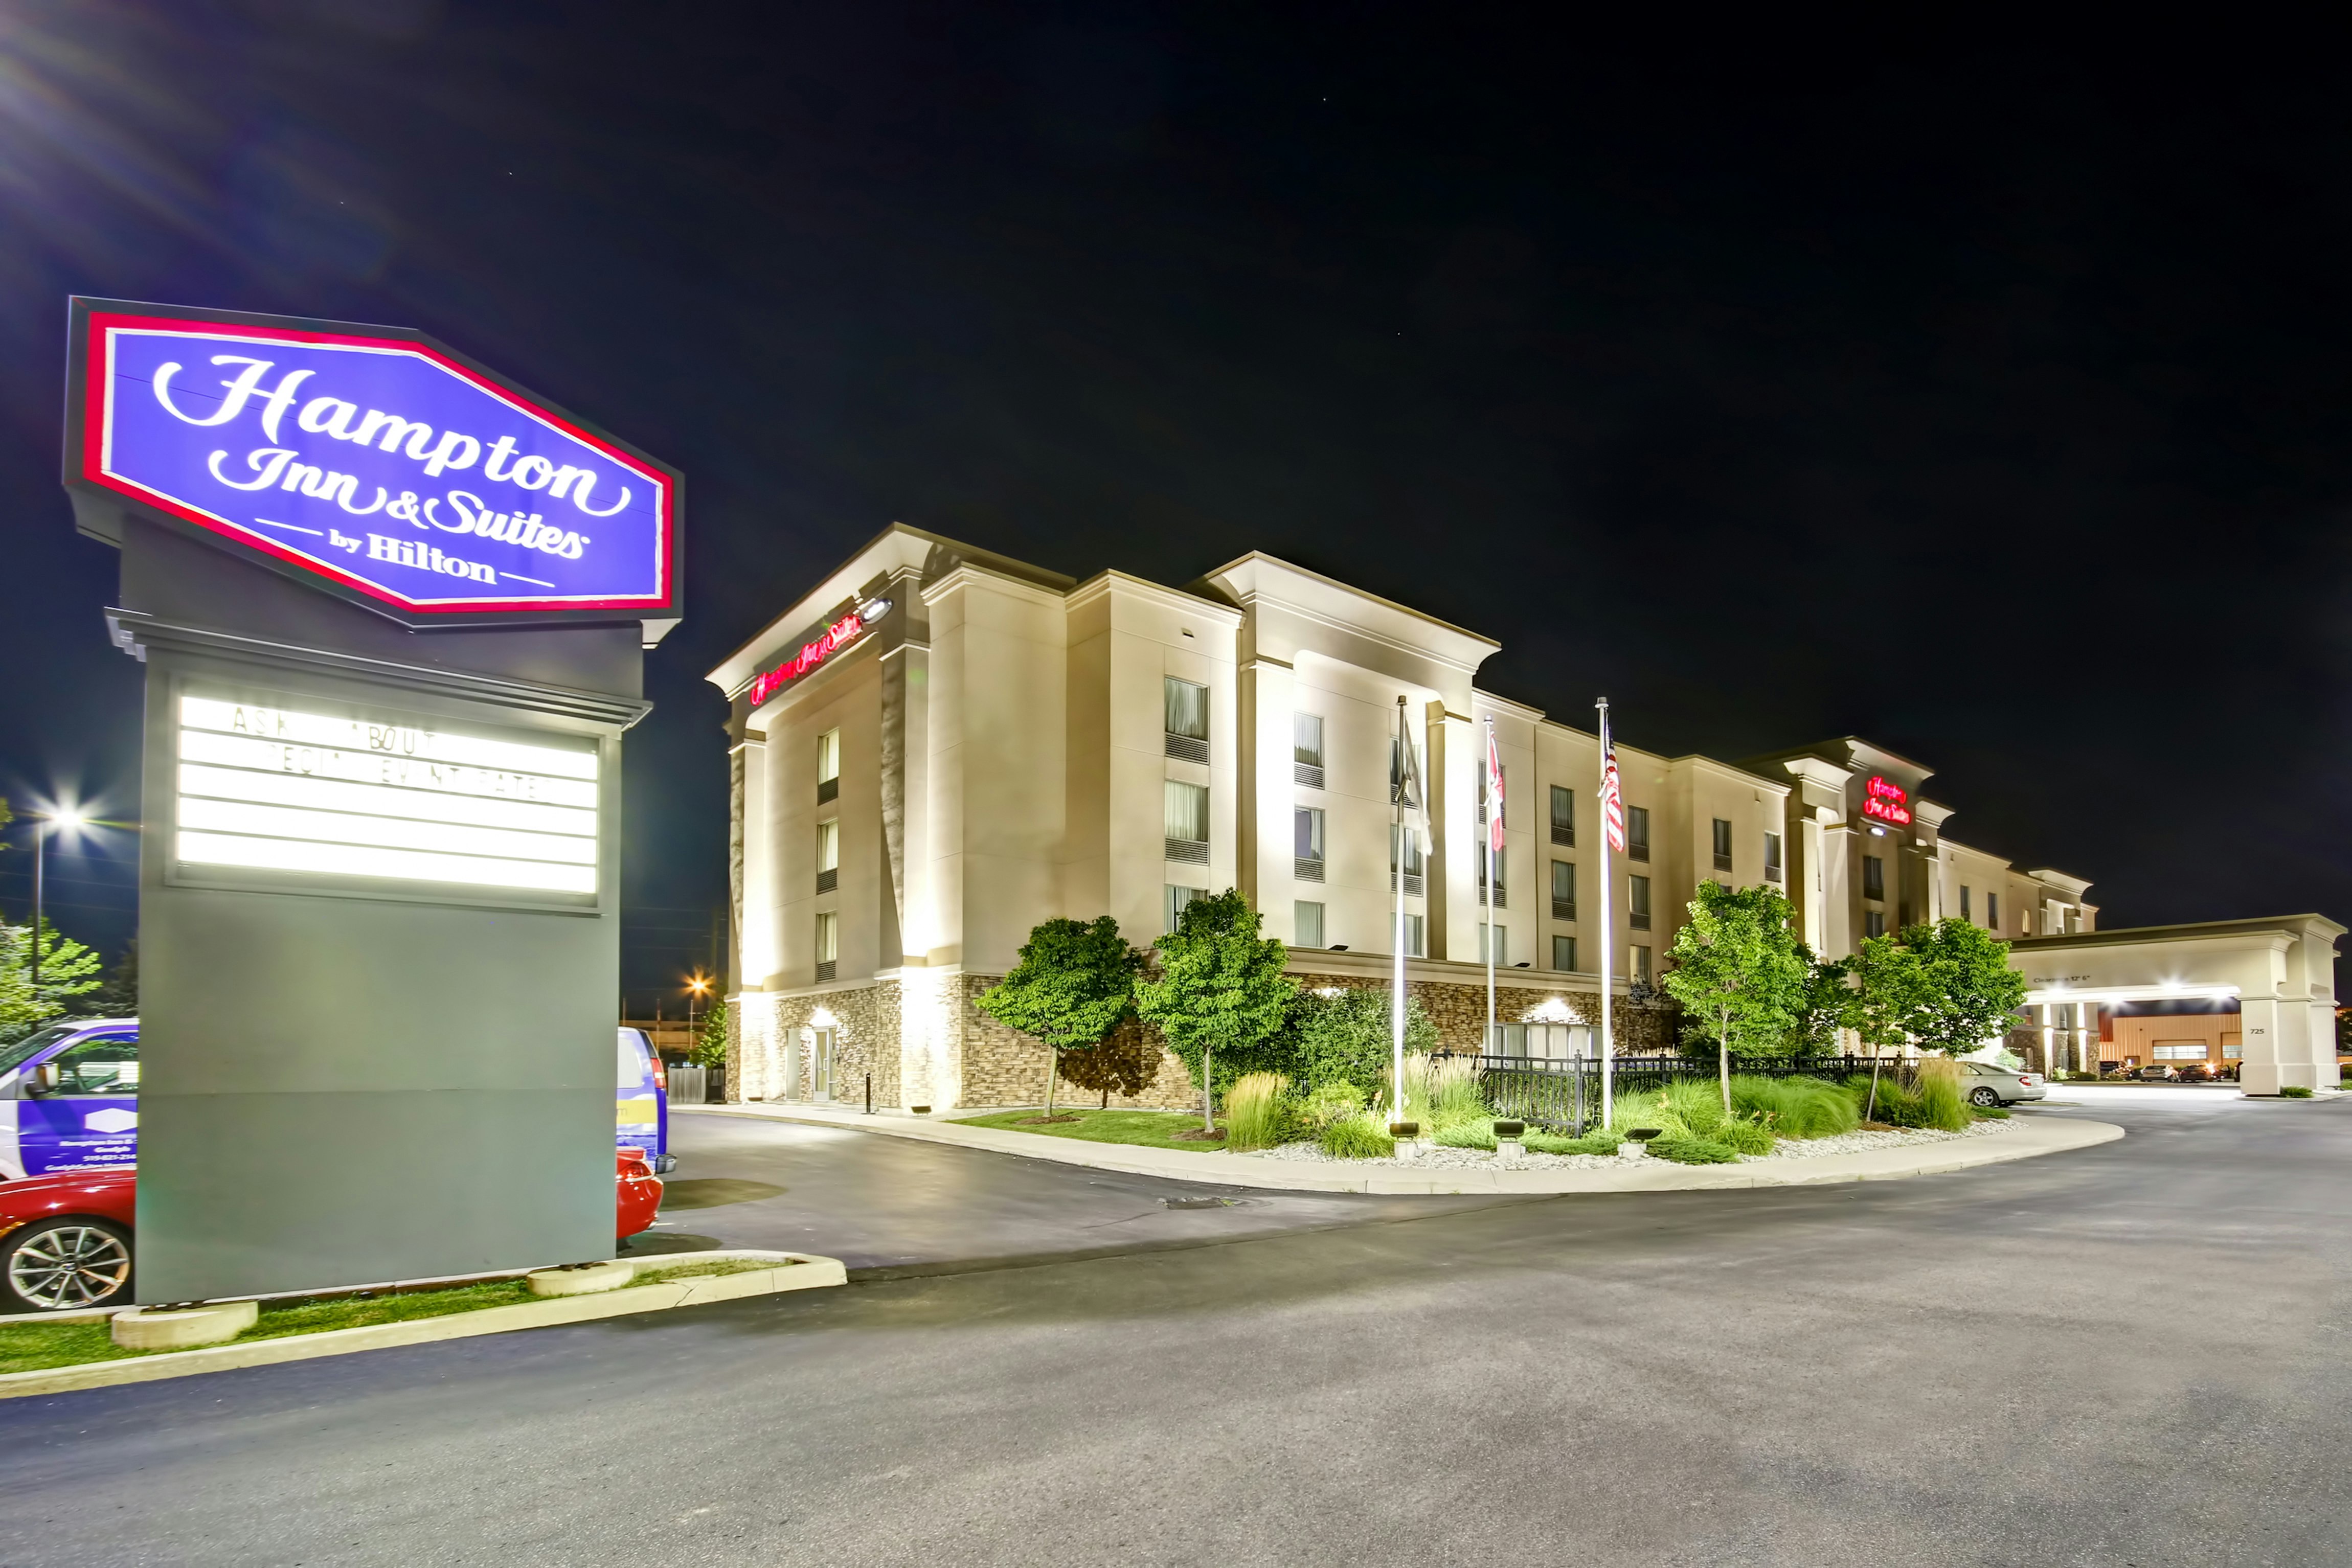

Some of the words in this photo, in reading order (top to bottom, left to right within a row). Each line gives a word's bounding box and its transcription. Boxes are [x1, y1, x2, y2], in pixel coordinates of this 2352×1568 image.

[153, 354, 632, 517] Hampton
[207, 447, 388, 515] Inn
[386, 490, 430, 530] &
[423, 490, 583, 559] Suites
[329, 529, 363, 553] by
[366, 533, 497, 585] Hilton
[234, 707, 289, 736] ASK
